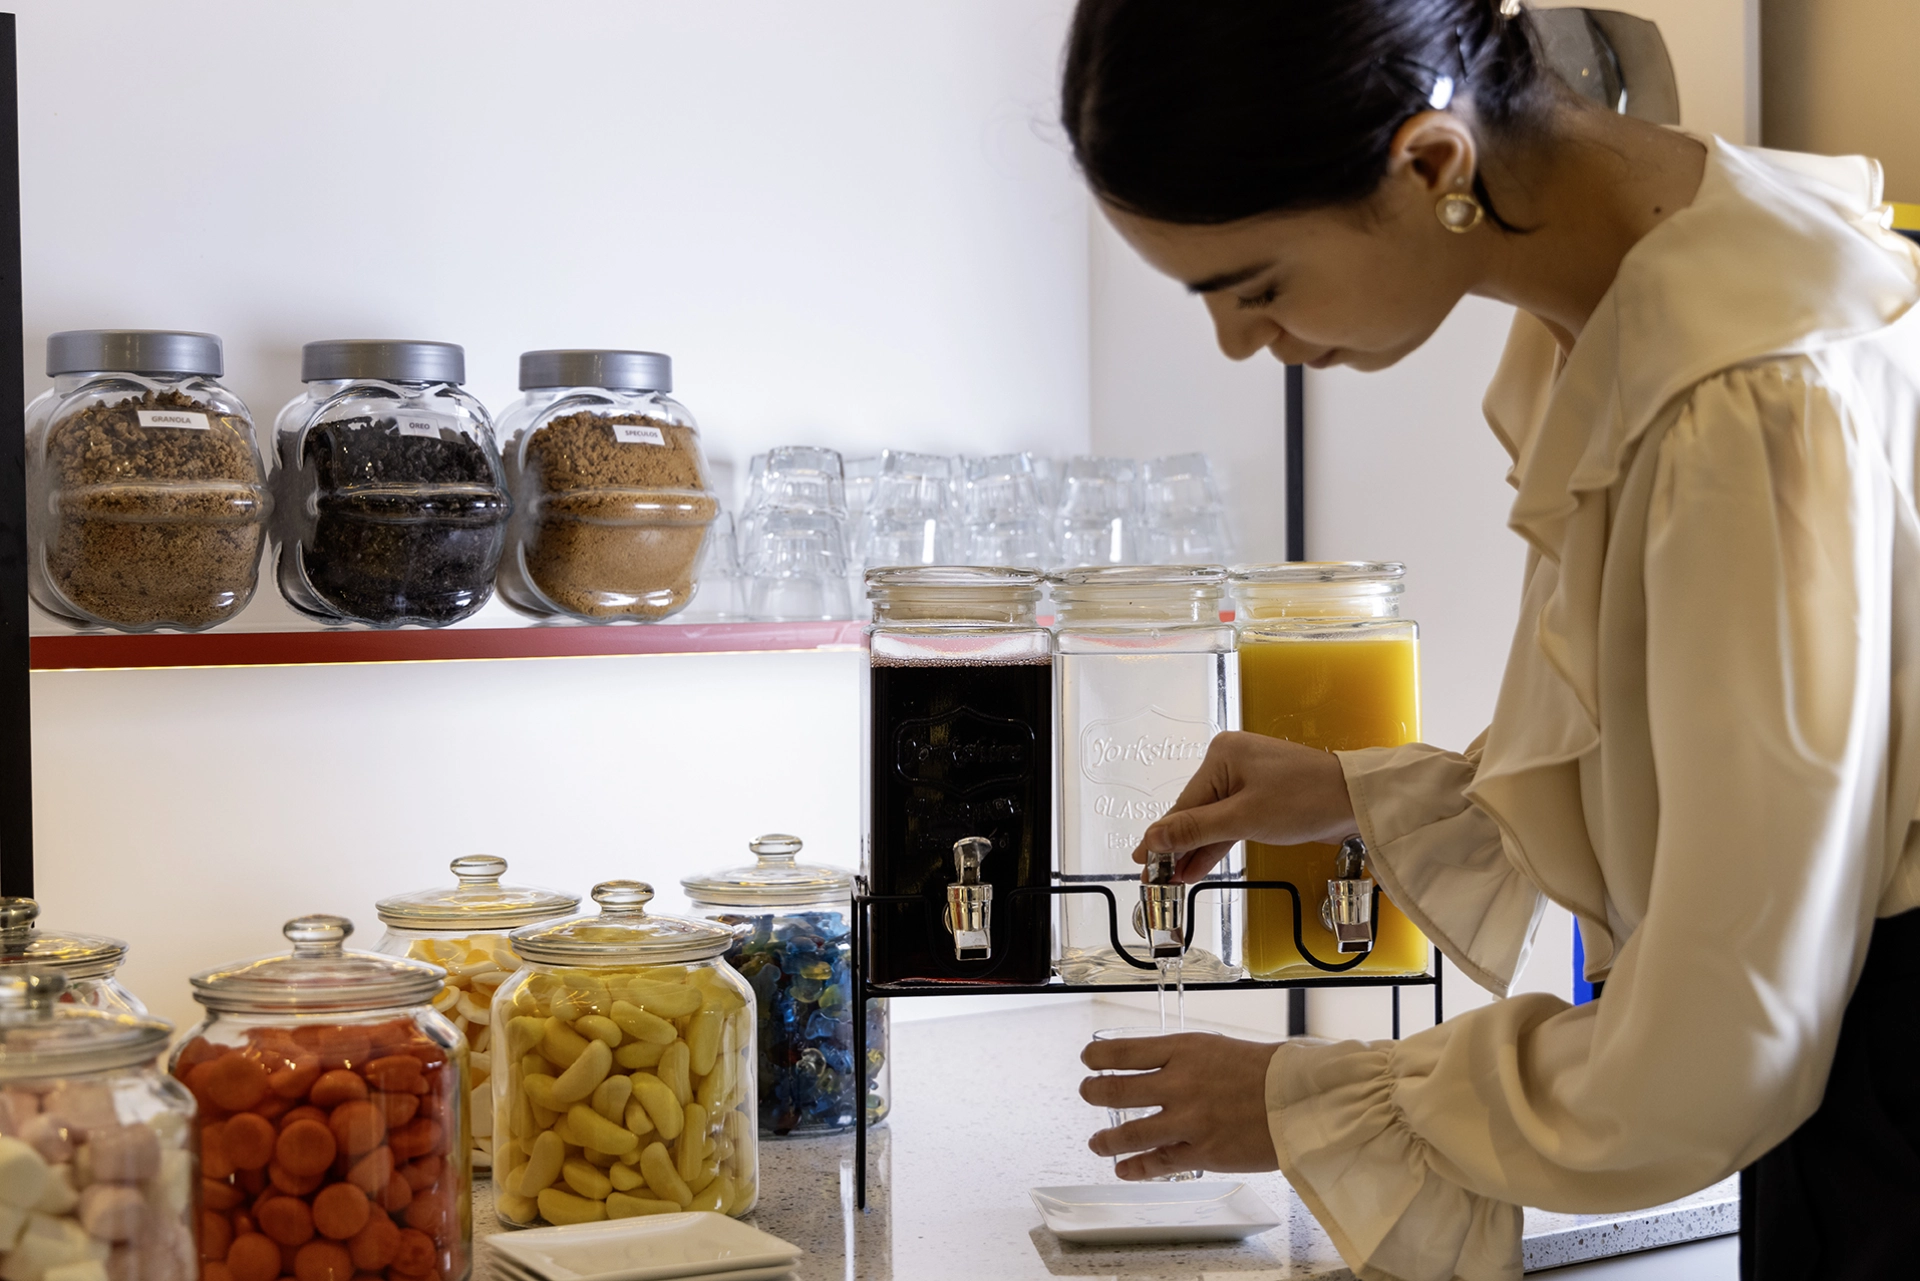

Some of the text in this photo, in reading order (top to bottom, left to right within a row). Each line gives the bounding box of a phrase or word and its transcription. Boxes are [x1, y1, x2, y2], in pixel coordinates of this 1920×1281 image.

[151, 415, 191, 424] GRANOLA
[409, 422, 430, 430] OREO
[625, 430, 658, 438] SPECULOS
[1094, 795, 1177, 820] GLASSW
